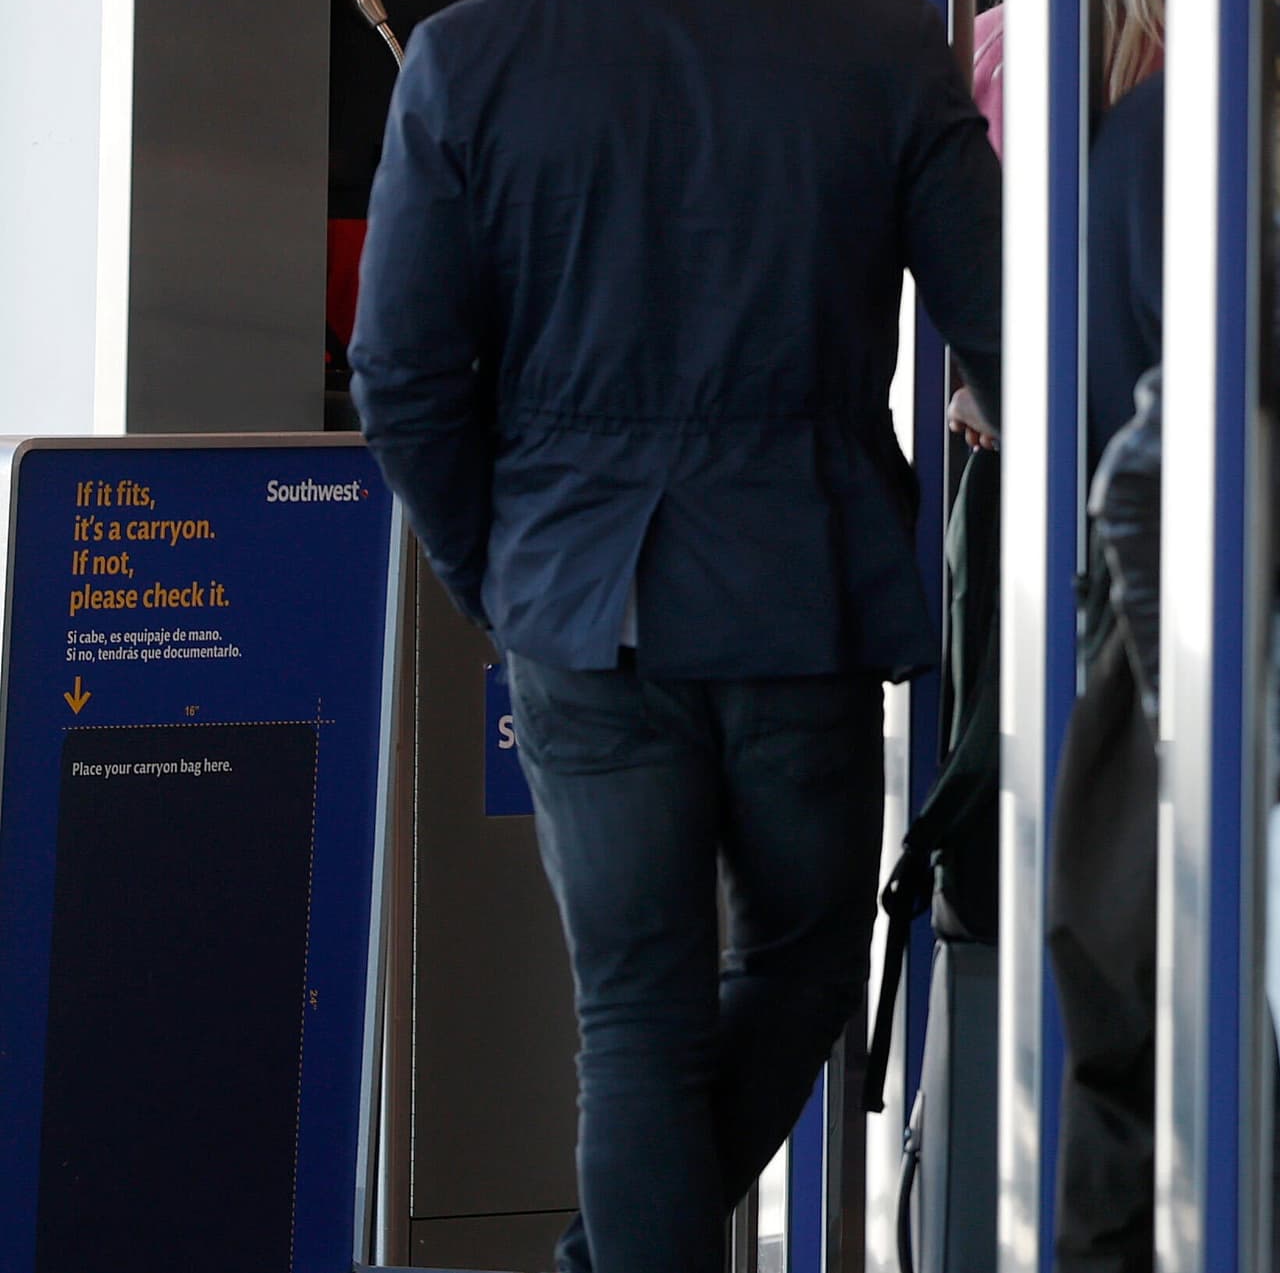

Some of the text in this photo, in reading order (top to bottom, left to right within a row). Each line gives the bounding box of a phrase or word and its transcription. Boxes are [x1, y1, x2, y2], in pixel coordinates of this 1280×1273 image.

[76, 480, 156, 510] If it fits,
[267, 478, 360, 502] Southwest
[108, 521, 121, 541] a
[126, 520, 216, 546] carryon.
[72, 550, 134, 578] If not,
[69, 580, 230, 616] please check it.
[67, 628, 222, 646] Si cabe, es equipaje de mano.
[66, 644, 242, 663] Si no, tendrás que documentarlo.
[72, 757, 233, 780] Place your carryon bag here.
